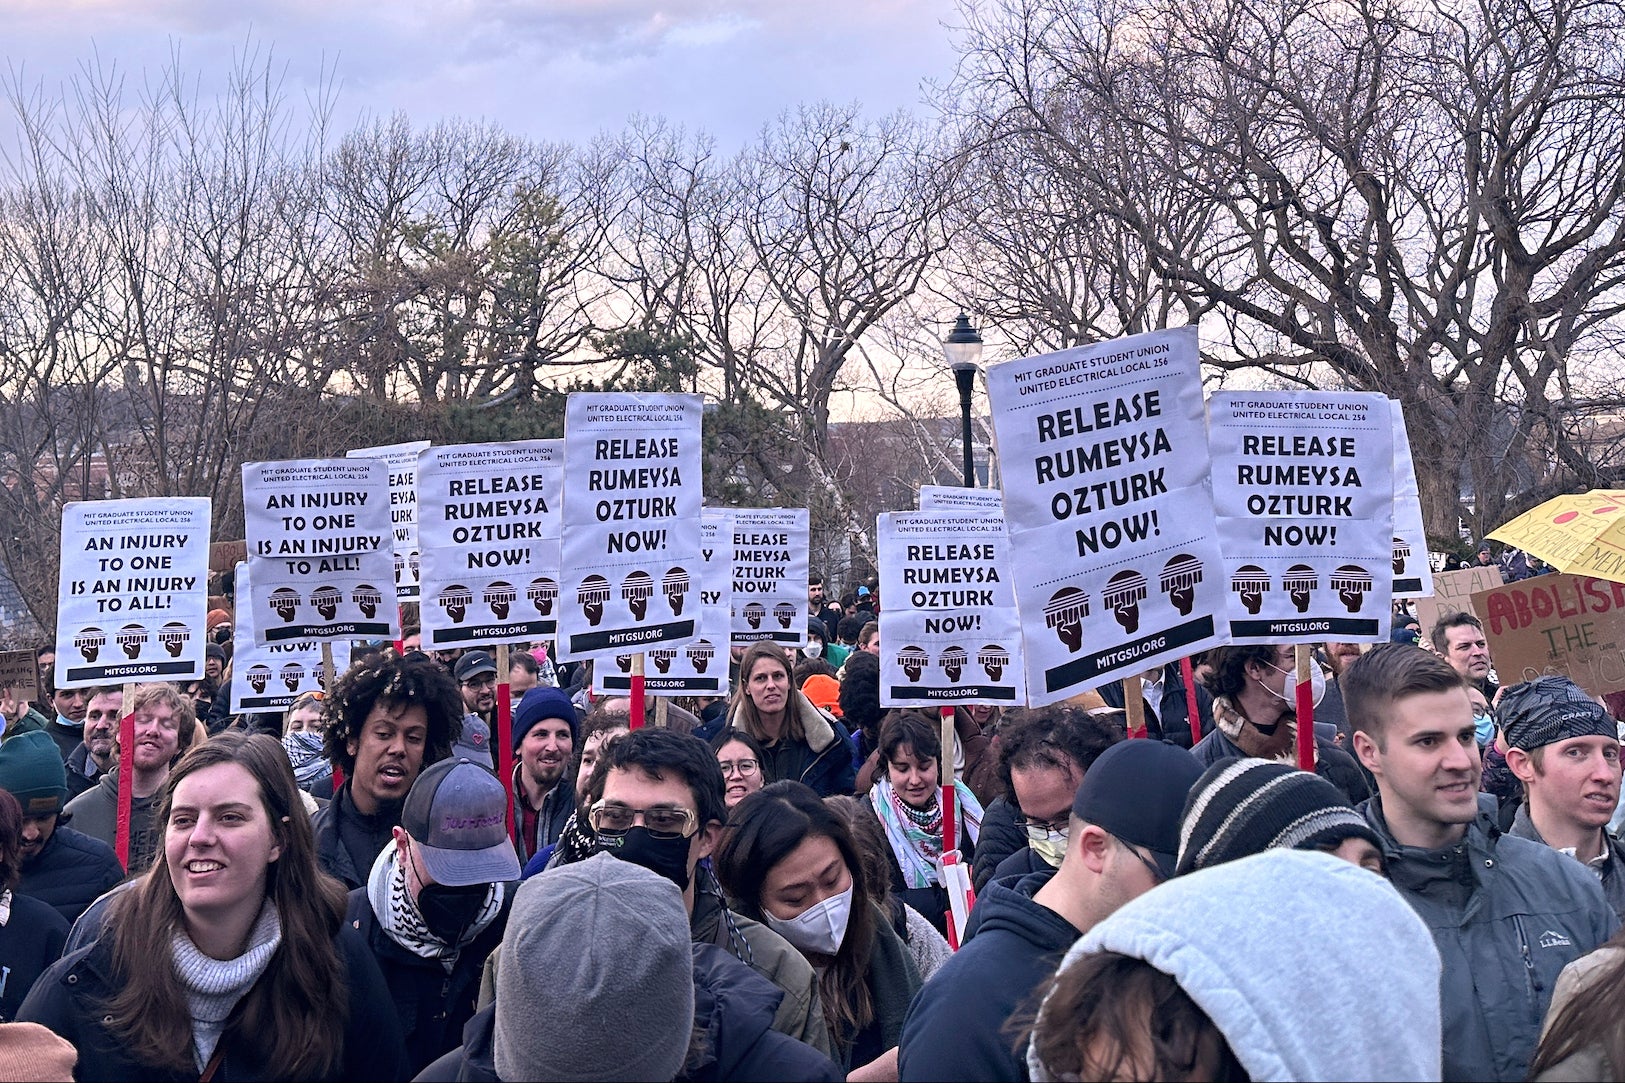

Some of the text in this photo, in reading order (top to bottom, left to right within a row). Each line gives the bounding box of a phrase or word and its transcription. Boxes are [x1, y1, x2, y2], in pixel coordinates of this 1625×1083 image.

[1014, 344, 1170, 383] MIT GRADUATE STUDENT UNION
[1019, 357, 1169, 396] UNITED ELECTRICAL LOCAL 256
[1247, 401, 1293, 409] GRADUATE
[1294, 402, 1335, 410] STUDENT
[1036, 390, 1162, 443] RELEASE
[452, 451, 490, 459] GRADUATE
[595, 438, 678, 460] RELEASE
[1242, 435, 1356, 458] RELEASE
[469, 458, 513, 466] ELECTRICAL
[1035, 428, 1172, 485] RUMEYSA
[389, 472, 414, 487] EASE
[589, 466, 682, 492] RUMEYSA
[1238, 465, 1361, 488] RUMEYSA
[449, 475, 543, 497] RELEASE
[1050, 468, 1168, 520] OZTURK
[266, 492, 368, 509] AN INJURY
[390, 491, 416, 505] EYSA
[1247, 495, 1352, 517] OZTURK
[391, 509, 412, 523] URK
[445, 497, 549, 521] RUMEYSA
[596, 497, 677, 522] OZTURK
[283, 514, 356, 531] TO ONE
[452, 522, 542, 544] OZTURK
[608, 530, 667, 554] NOW!
[733, 533, 788, 545] ELEASE
[1076, 510, 1161, 556] NOW!
[1264, 525, 1337, 547] NOW!
[85, 534, 188, 551] AN INJURY
[258, 535, 381, 554] IS AN INJURY
[467, 548, 531, 568] NOW!
[907, 544, 995, 561] RELEASE
[99, 555, 172, 572] TO ONE
[286, 556, 361, 574] TO ALL!
[732, 567, 786, 579] ZTURK
[904, 565, 1000, 586] RUMEYSA
[72, 577, 196, 596] IS AN INJURY
[732, 581, 777, 593] NOW!
[97, 595, 172, 612] TO ALL!
[911, 590, 993, 608] OZTURK
[304, 624, 355, 635] MITGSU.ORG
[472, 624, 527, 637] MITGSU.ORG
[925, 615, 982, 634] NOW!
[1269, 621, 1330, 634] MITGSU.ORG
[609, 629, 663, 643] MITGSU.ORG
[1540, 622, 1598, 657] THE
[1096, 635, 1167, 670] MITGSU.ORG
[104, 664, 158, 676] MITGSU.ORG
[927, 688, 978, 699] MITGSU.ORG
[1562, 711, 1593, 720] CRAFT
